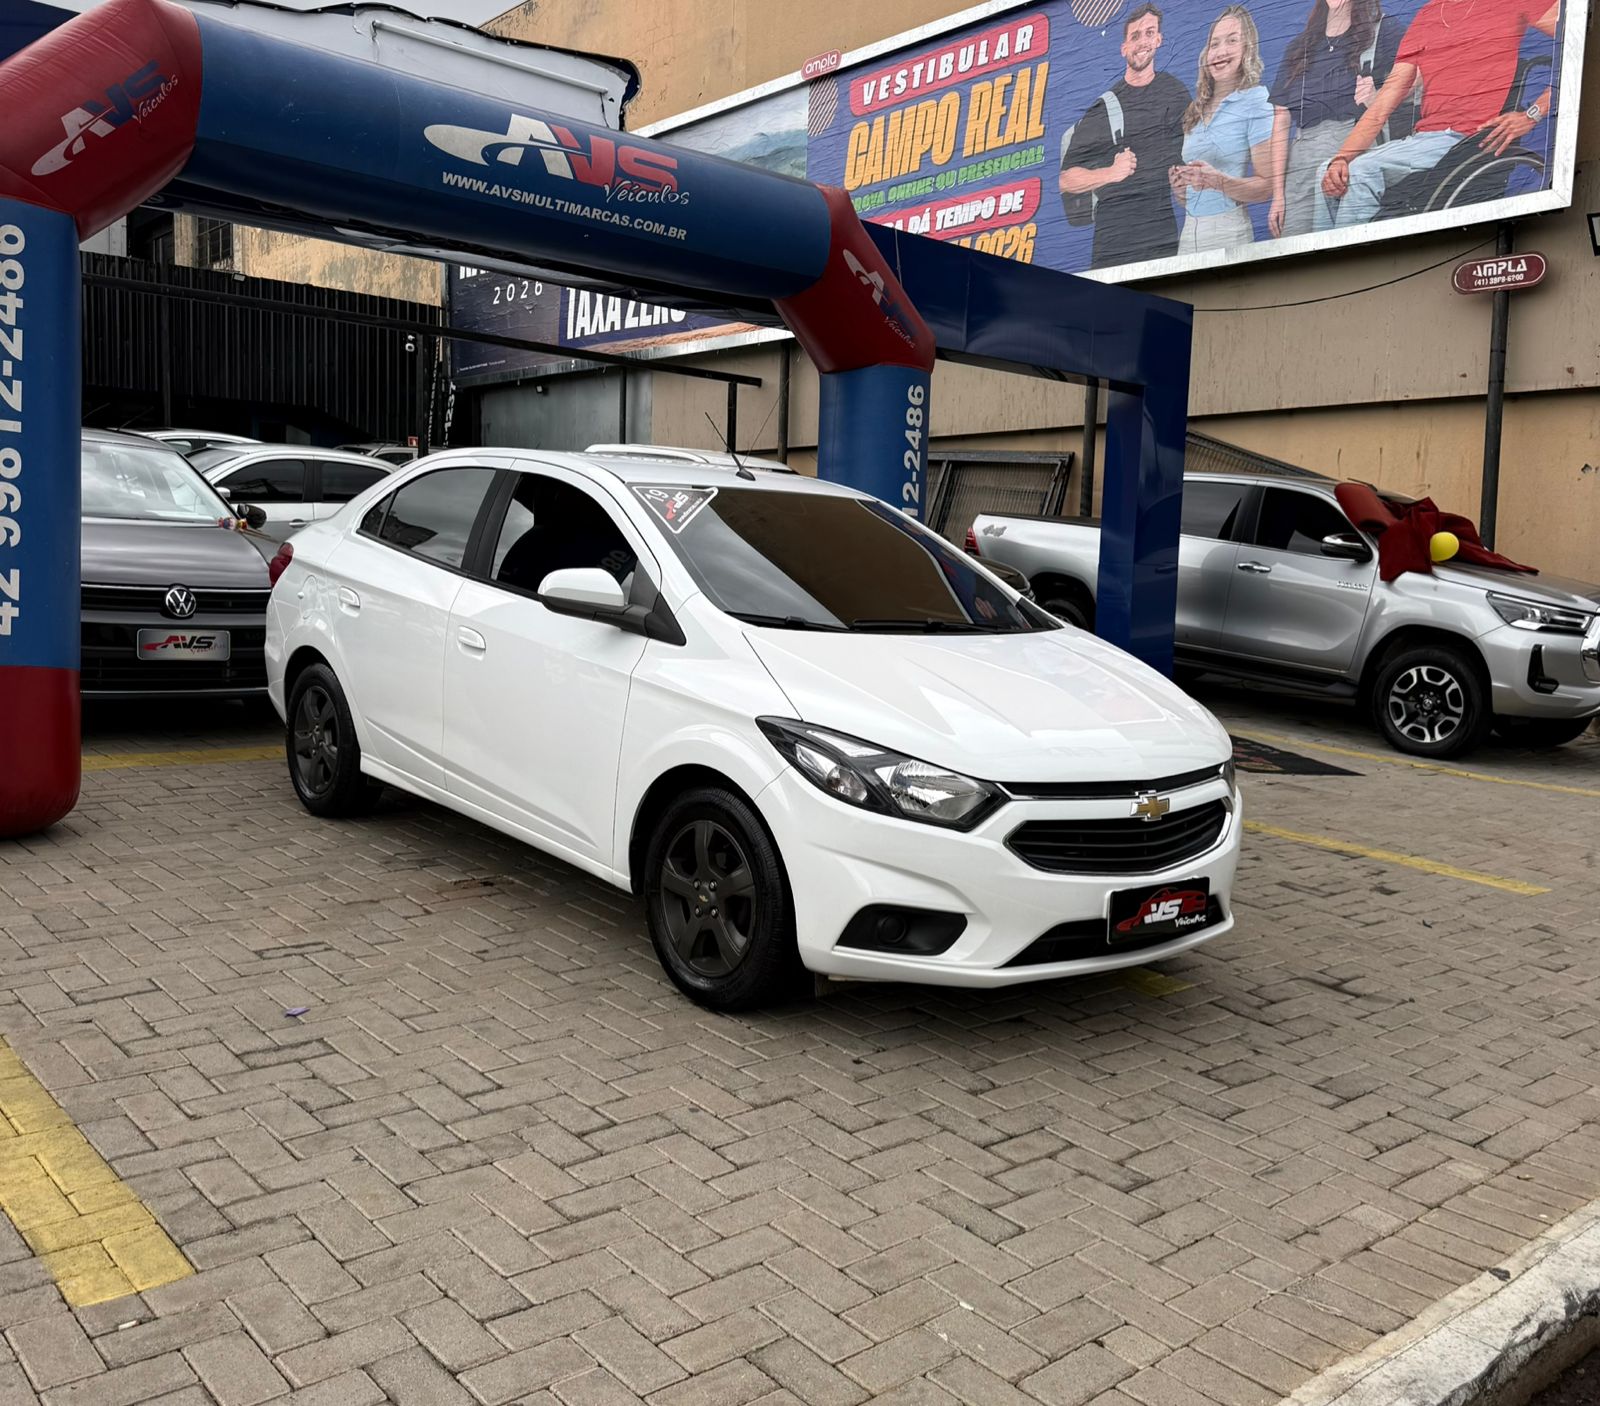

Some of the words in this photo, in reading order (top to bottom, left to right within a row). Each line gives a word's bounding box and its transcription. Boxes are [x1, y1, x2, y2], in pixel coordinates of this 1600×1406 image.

[805, 53, 838, 74] ampla
[862, 24, 1034, 106] VESTIBULAR
[131, 73, 179, 125] Veículos
[844, 91, 960, 190] CAMPO
[962, 62, 1049, 158] REAL
[496, 113, 678, 192] AVS
[441, 171, 688, 240] WWW.AVSMULTIMARCAS.COM.BR
[603, 180, 690, 206] Veículos
[852, 190, 886, 214] ROVA
[907, 207, 932, 235] DÁ
[935, 195, 997, 231] TEMPO
[998, 189, 1025, 215] DE
[492, 280, 543, 305] 2026
[1472, 259, 1527, 277] AMPLA
[566, 286, 621, 340] TAXA
[0, 568, 20, 636] 42
[160, 635, 216, 649] AVS
